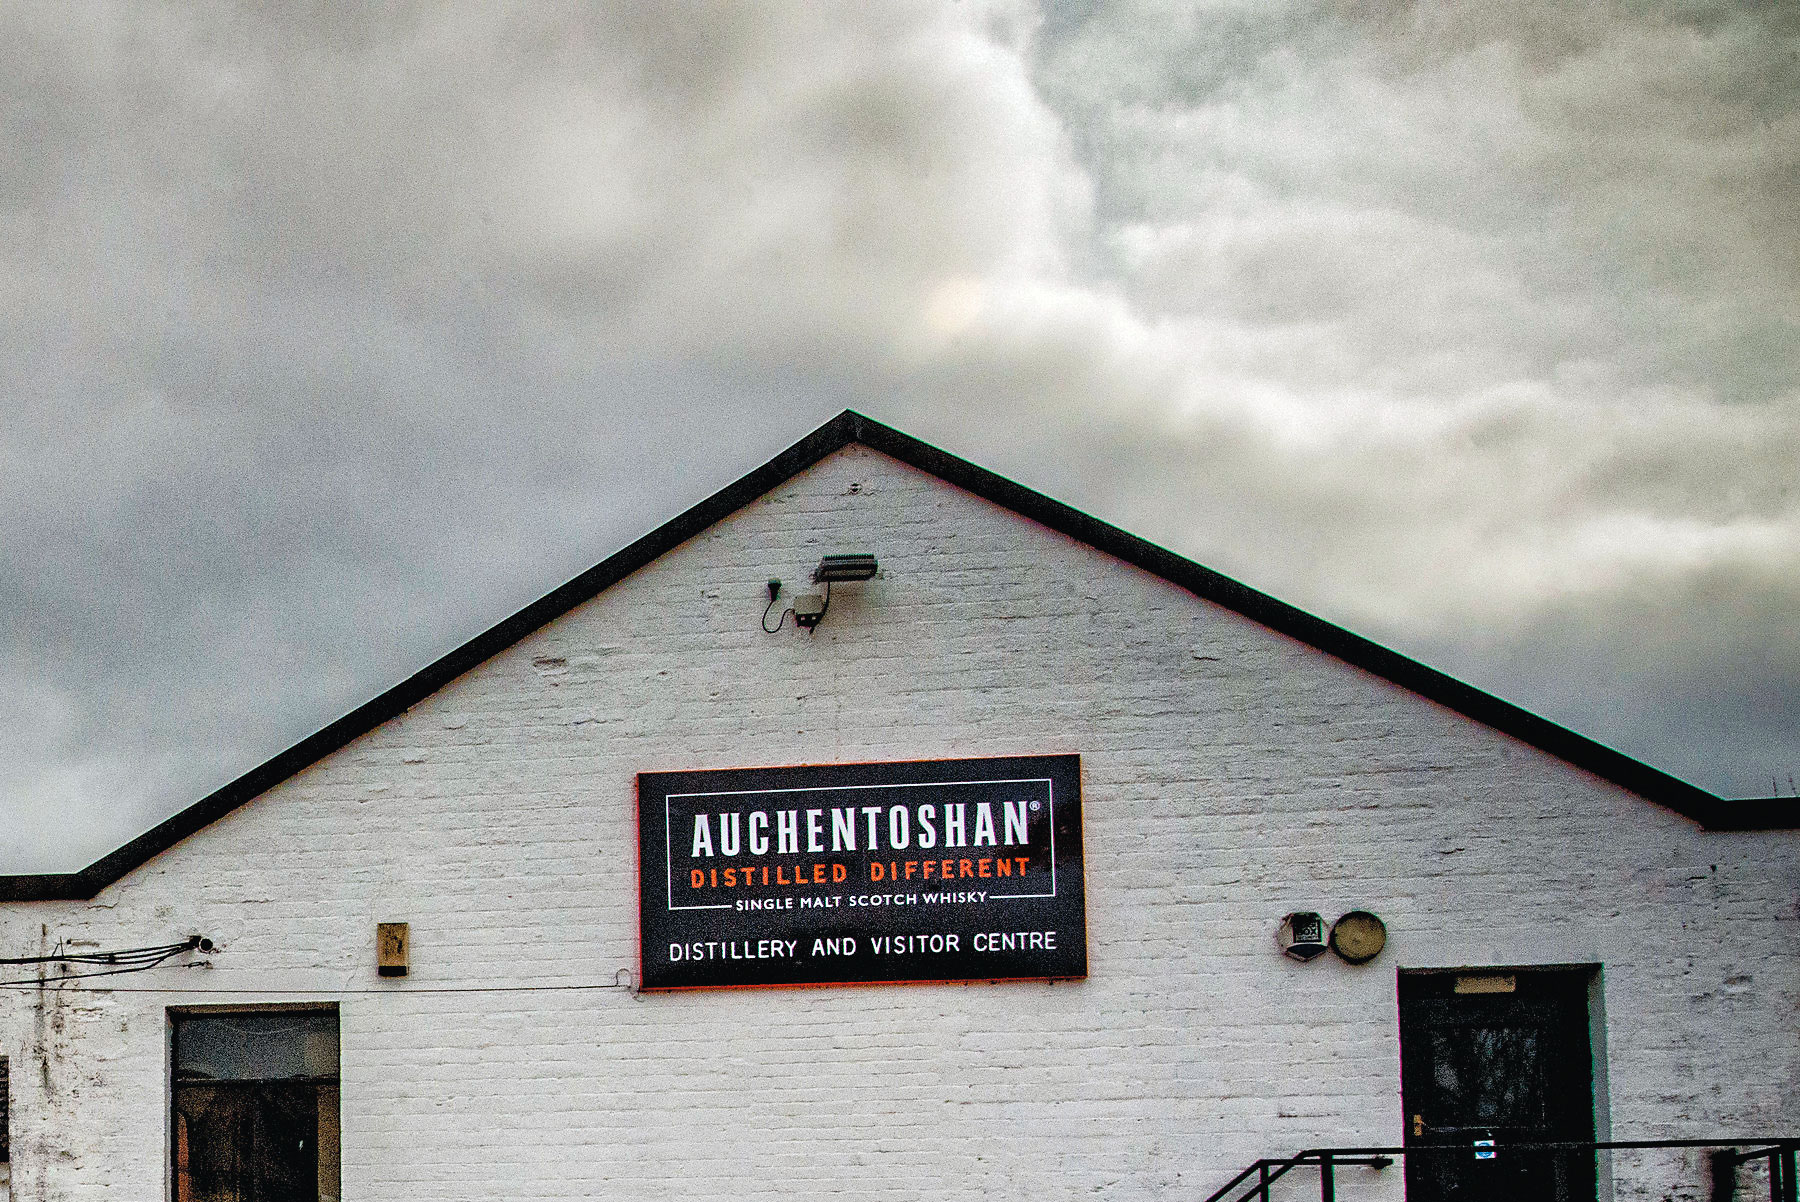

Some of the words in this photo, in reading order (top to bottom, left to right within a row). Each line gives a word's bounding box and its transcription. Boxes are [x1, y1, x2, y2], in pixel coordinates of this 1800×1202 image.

[690, 863, 847, 889] DISTILLED
[870, 857, 1030, 882] DIFFERENT
[735, 897, 793, 912] SINGLE
[800, 895, 842, 909] MALT
[849, 893, 918, 907] SCOTCH
[922, 891, 987, 905] WHISKY
[669, 940, 797, 962] DISTILLERY
[811, 937, 857, 957] AND
[870, 933, 960, 955] VISITOR
[973, 931, 1057, 952] CENTRE
